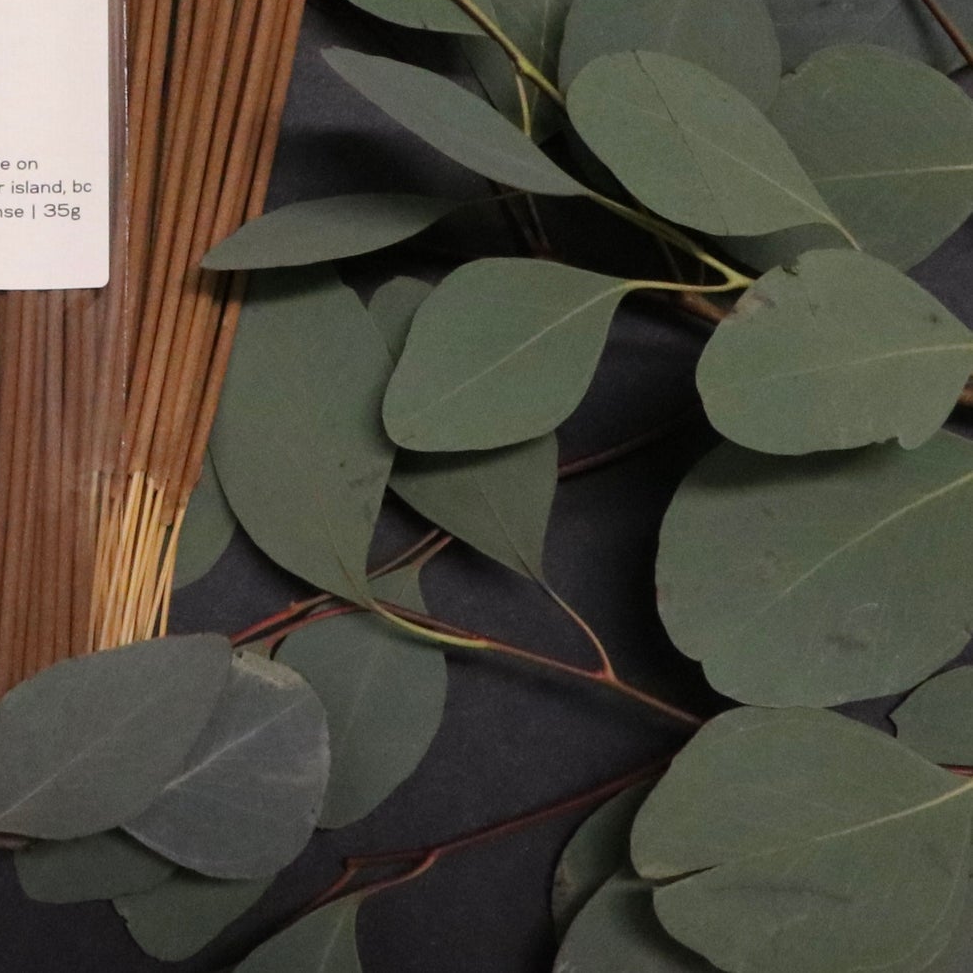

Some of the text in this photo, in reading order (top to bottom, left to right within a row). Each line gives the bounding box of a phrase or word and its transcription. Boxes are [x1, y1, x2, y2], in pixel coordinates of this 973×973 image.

[16, 160, 39, 171] on
[10, 180, 67, 196] island,
[72, 179, 93, 194] bc
[43, 203, 81, 221] 35g
